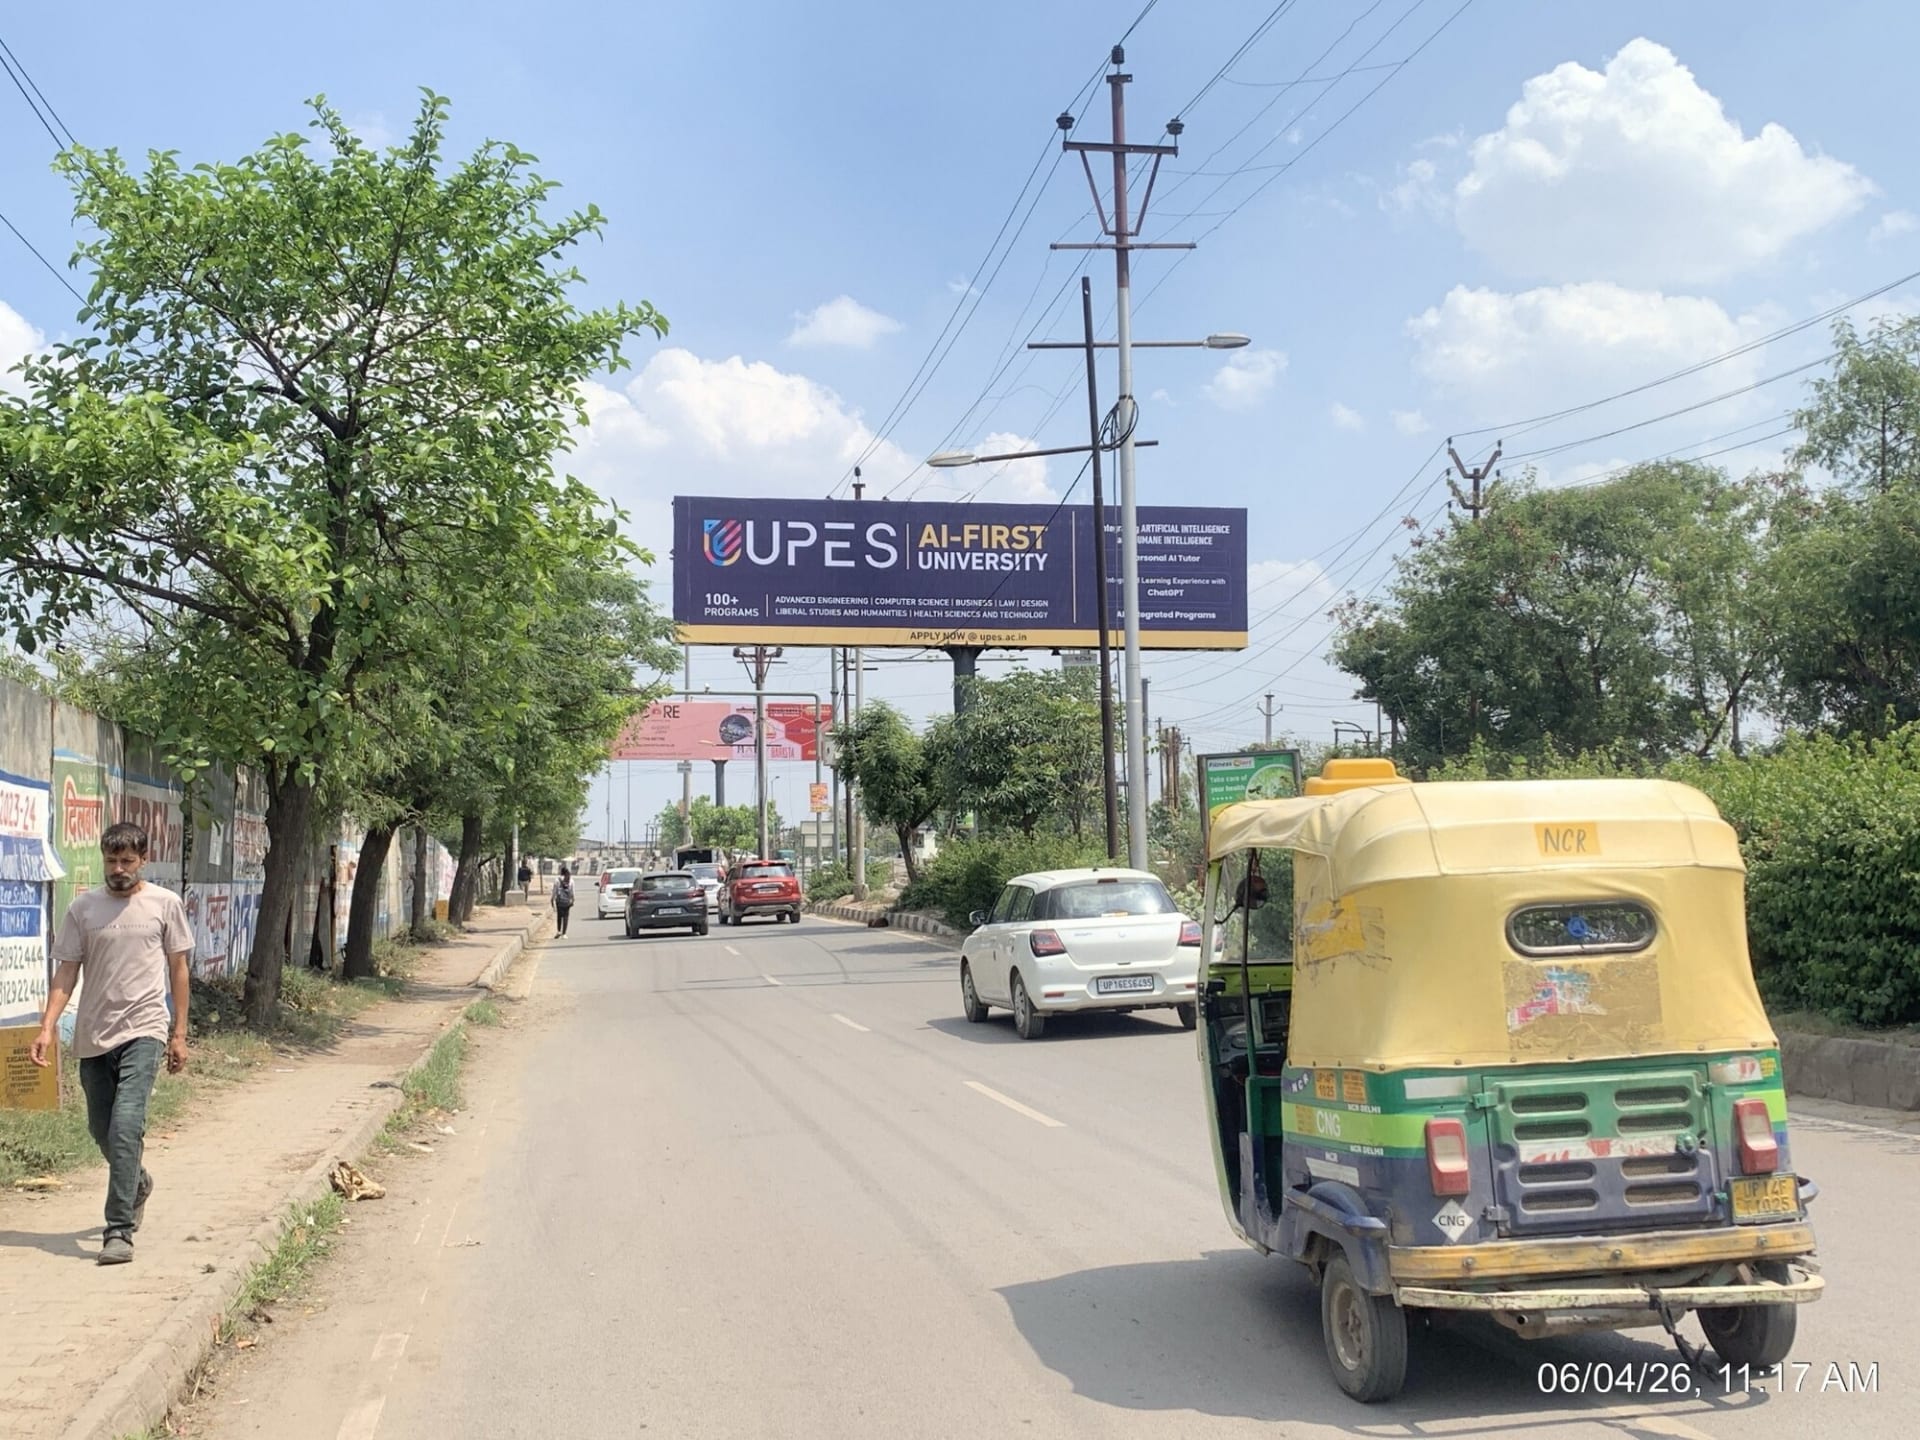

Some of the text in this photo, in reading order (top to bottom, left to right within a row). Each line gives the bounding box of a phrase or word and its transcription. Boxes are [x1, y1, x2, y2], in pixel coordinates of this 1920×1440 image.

[1140, 523, 1180, 534] ARTIFICIAL
[1181, 524, 1230, 534] INTELLIGENCE
[918, 523, 1049, 550] AI-FIRST
[1137, 535, 1213, 545] UMANE INTELLIGENCE
[745, 519, 899, 569] UPES
[918, 551, 1048, 572] UNIVERSITY
[1168, 554, 1177, 562] AI
[1178, 554, 1201, 562] Tutor
[1141, 577, 1171, 586] Learning
[1172, 577, 1209, 586] Experience
[1147, 588, 1184, 597] ChatGPT
[705, 593, 739, 606] 100+
[775, 596, 1048, 608] ADVANCED ENGINEERING COMPUTER SCIENCE BUSINESS LAW DESIGN
[704, 607, 760, 617] PROGRAMS
[775, 607, 807, 616] LIBERAL
[808, 607, 842, 616] STUDIES
[843, 608, 859, 616] AND
[861, 608, 908, 617] HUMANITIES
[913, 610, 943, 618] HEALTH
[982, 610, 998, 619] AND
[1000, 611, 1048, 619] TECHNOLOGY
[1174, 611, 1216, 620] Programs
[910, 632, 941, 641] APPLY
[943, 631, 965, 641] NOW
[979, 633, 1028, 642] upes.ac.in
[1543, 828, 1587, 853] NCR
[1291, 1072, 1309, 1093] NCR
[1316, 1110, 1342, 1137] CNG
[1438, 1216, 1466, 1228] CNG
